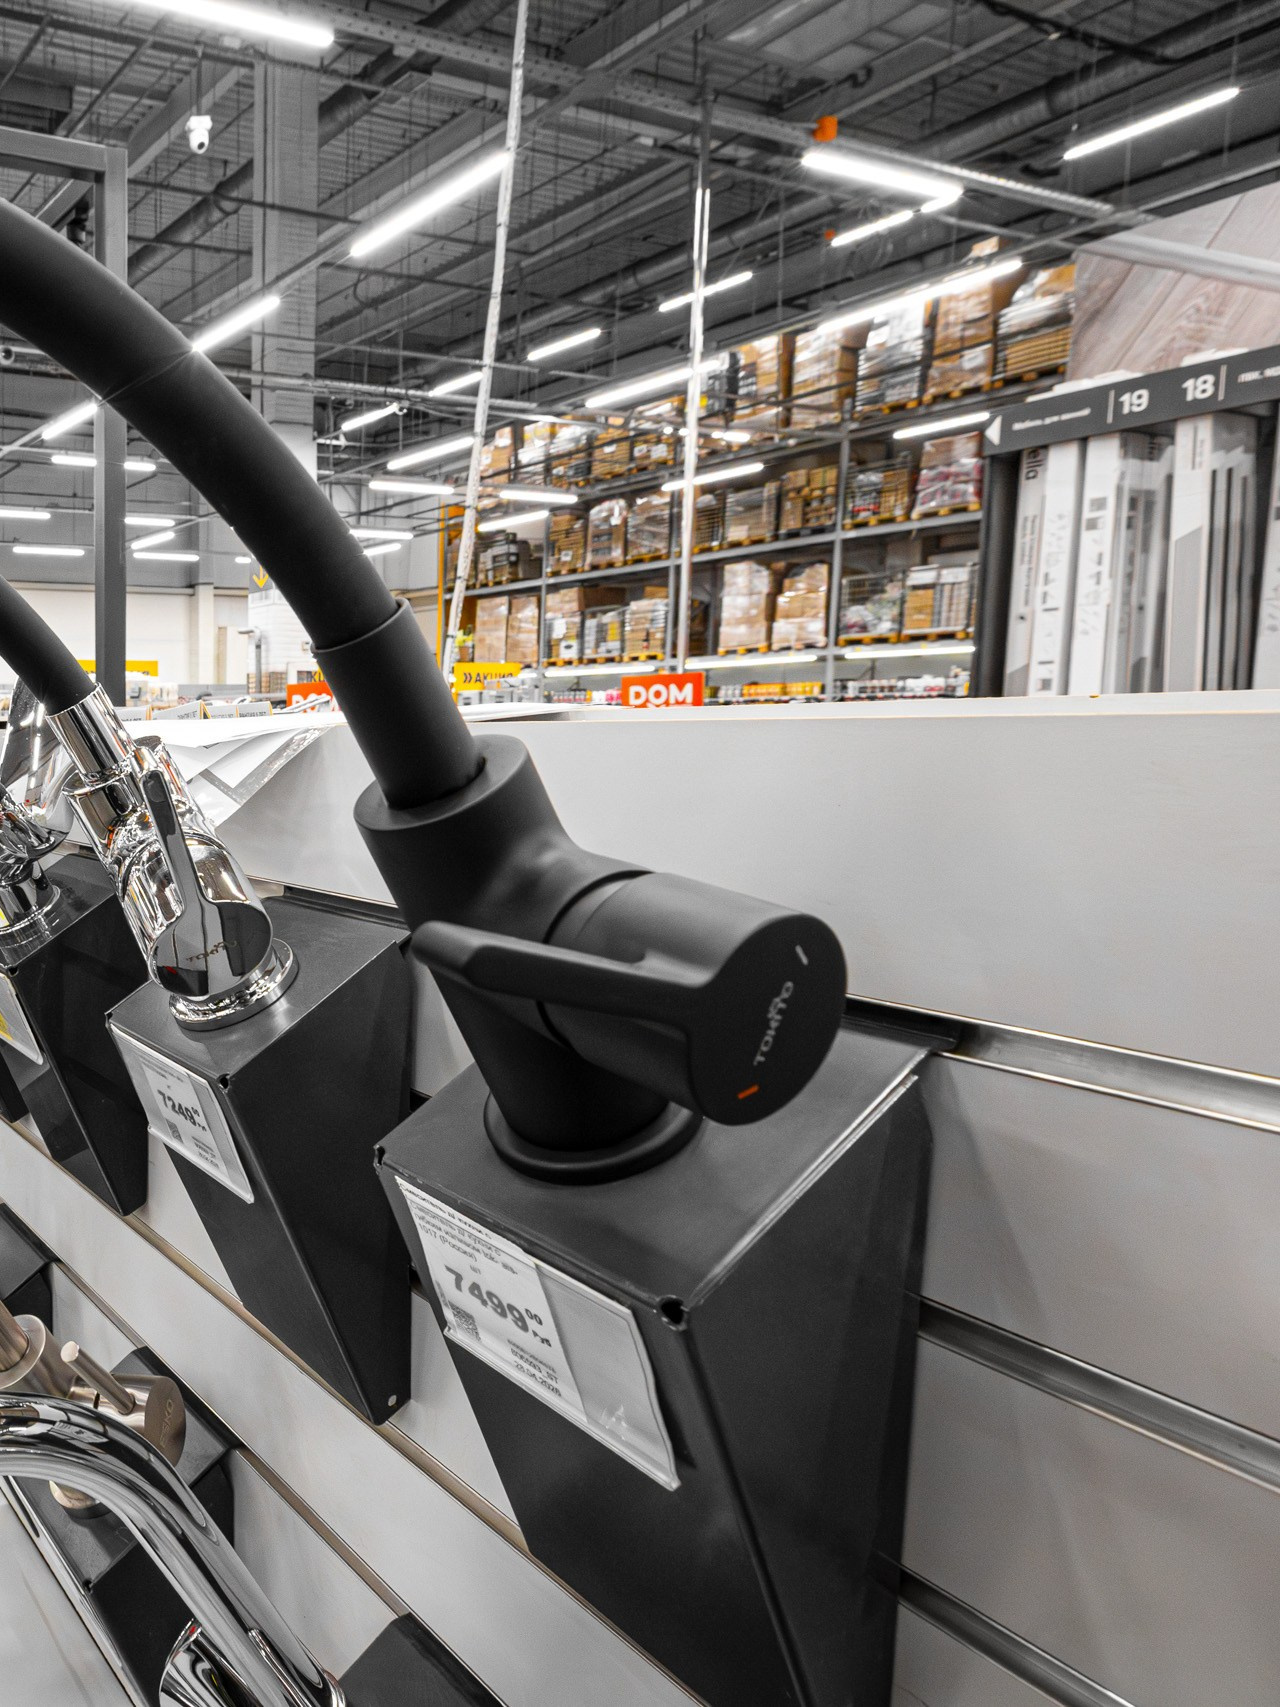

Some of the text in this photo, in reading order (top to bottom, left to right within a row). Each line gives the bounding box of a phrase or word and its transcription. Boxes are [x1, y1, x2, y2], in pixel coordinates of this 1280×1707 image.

[1181, 374, 1215, 401] 18
[1119, 389, 1149, 415] 19
[629, 682, 694, 706] DOM
[157, 1089, 197, 1127] 7249
[444, 1264, 529, 1333] 7499
